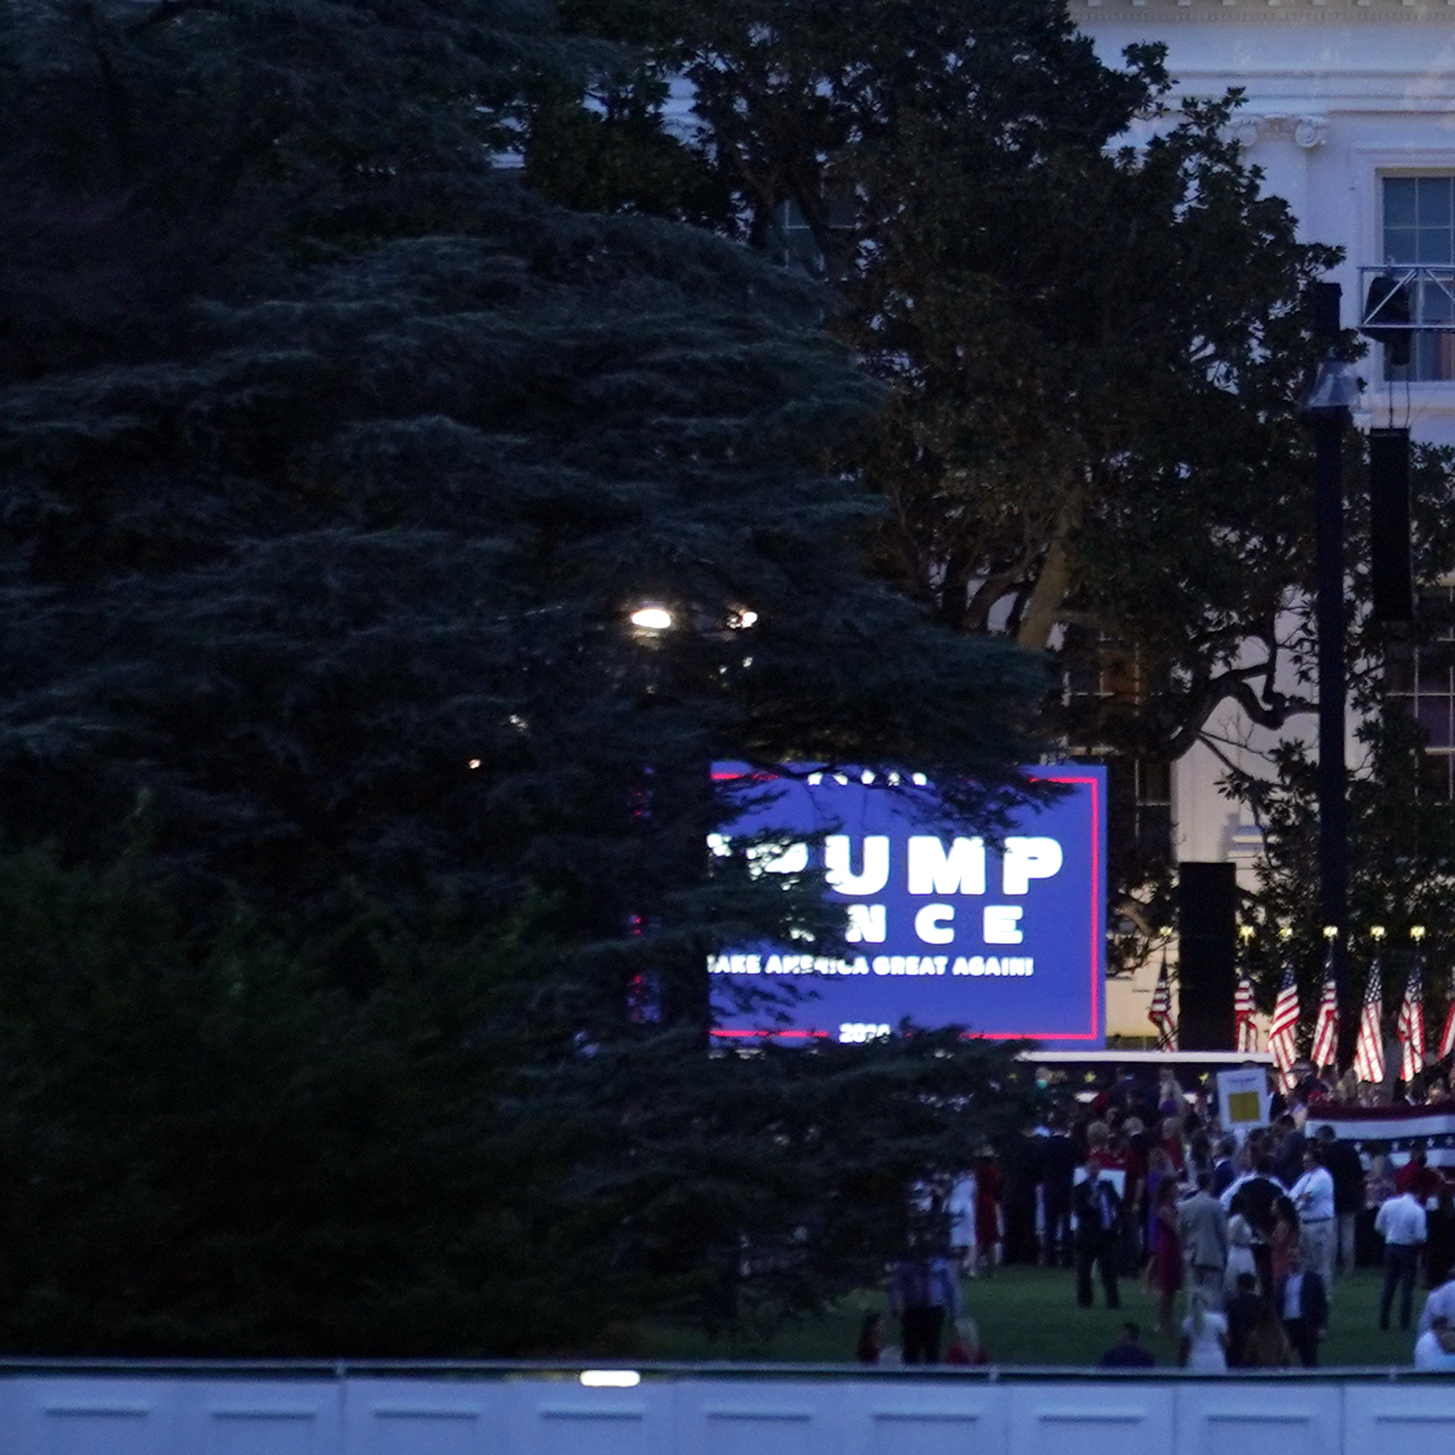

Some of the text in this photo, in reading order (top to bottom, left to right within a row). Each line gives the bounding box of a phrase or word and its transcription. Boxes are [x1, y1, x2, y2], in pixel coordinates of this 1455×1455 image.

[706, 832, 1063, 896] UMP
[872, 955, 948, 975] GREAT
[952, 955, 1034, 977] AGAIN!
